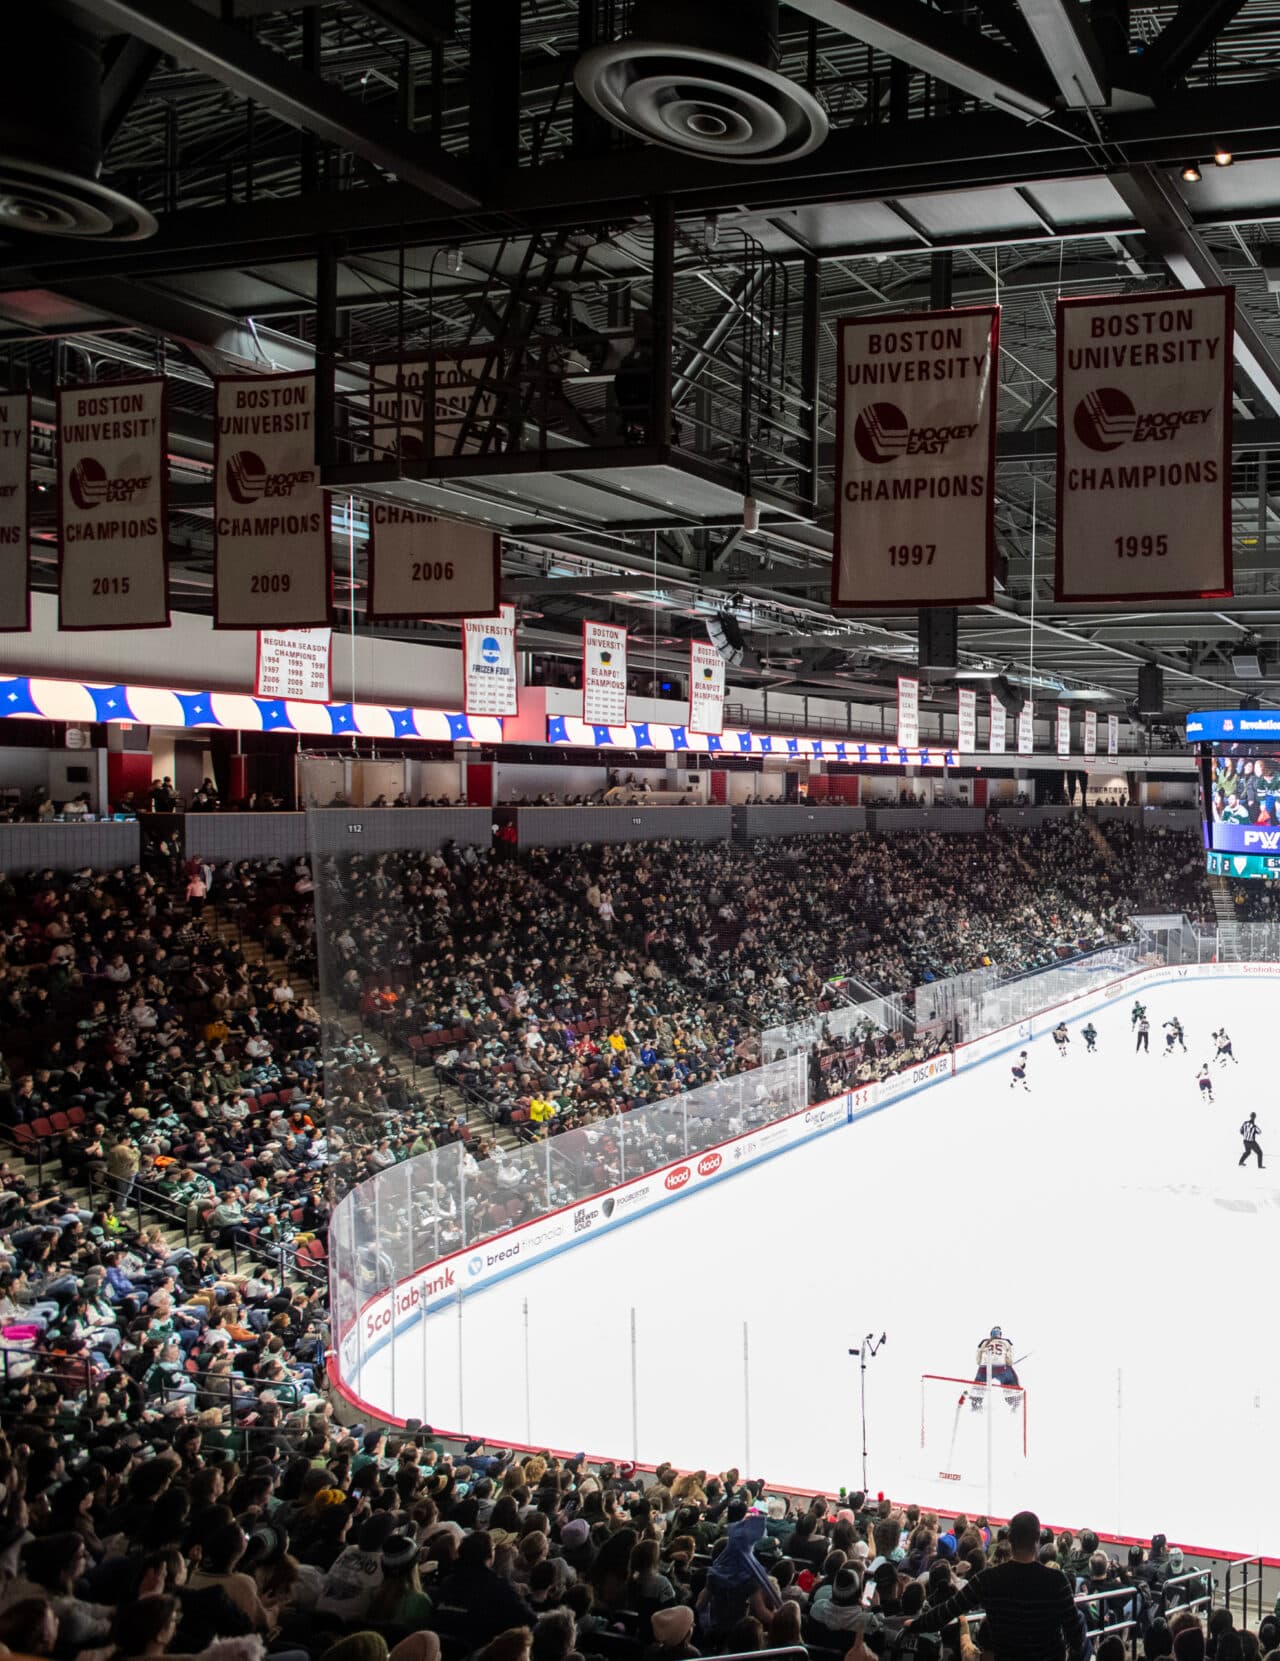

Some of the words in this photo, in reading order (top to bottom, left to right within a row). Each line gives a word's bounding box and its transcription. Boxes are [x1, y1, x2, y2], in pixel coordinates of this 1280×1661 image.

[1090, 308, 1193, 338] BOSTON
[868, 327, 962, 354] BOSTON
[1067, 336, 1220, 371] UNIVERSITY
[847, 354, 986, 385] UNIVERSITY
[78, 394, 144, 417] BOSTON
[236, 386, 306, 408] BOSTON
[219, 412, 311, 435] UNIVERSIT
[1136, 407, 1213, 428] HOCKEY
[64, 417, 157, 443] UNIVERSITY
[908, 423, 979, 442] HOCKEY
[1132, 425, 1180, 442] EAST
[905, 439, 948, 455] EAST
[1068, 460, 1218, 491] CHAMPIONS
[106, 489, 135, 503] EAST
[264, 484, 295, 497] EAST
[845, 474, 984, 502] CHAMPIONS
[66, 518, 158, 543] CHAMPIONS
[218, 513, 320, 537] CHAMPIONS
[888, 544, 937, 567] 1997
[1114, 534, 1168, 559] 1995
[412, 562, 454, 581] 2006
[92, 577, 130, 595] 2015
[251, 574, 291, 594] 2009
[466, 623, 514, 636] UNIVERSITY
[592, 628, 619, 639] BOSTON
[263, 637, 297, 648] REGULAR
[298, 643, 327, 652] SEASON
[274, 648, 317, 661] CHAMPIONS
[592, 667, 620, 678] BEANPOT
[586, 679, 625, 690] CHAMPIONS
[912, 1058, 948, 1084] DISCOVER
[700, 1157, 720, 1173] Hood
[667, 1173, 689, 1187] Hood
[574, 1210, 599, 1226] BREWED
[574, 1221, 592, 1233] LOUD
[487, 1242, 520, 1266] bread
